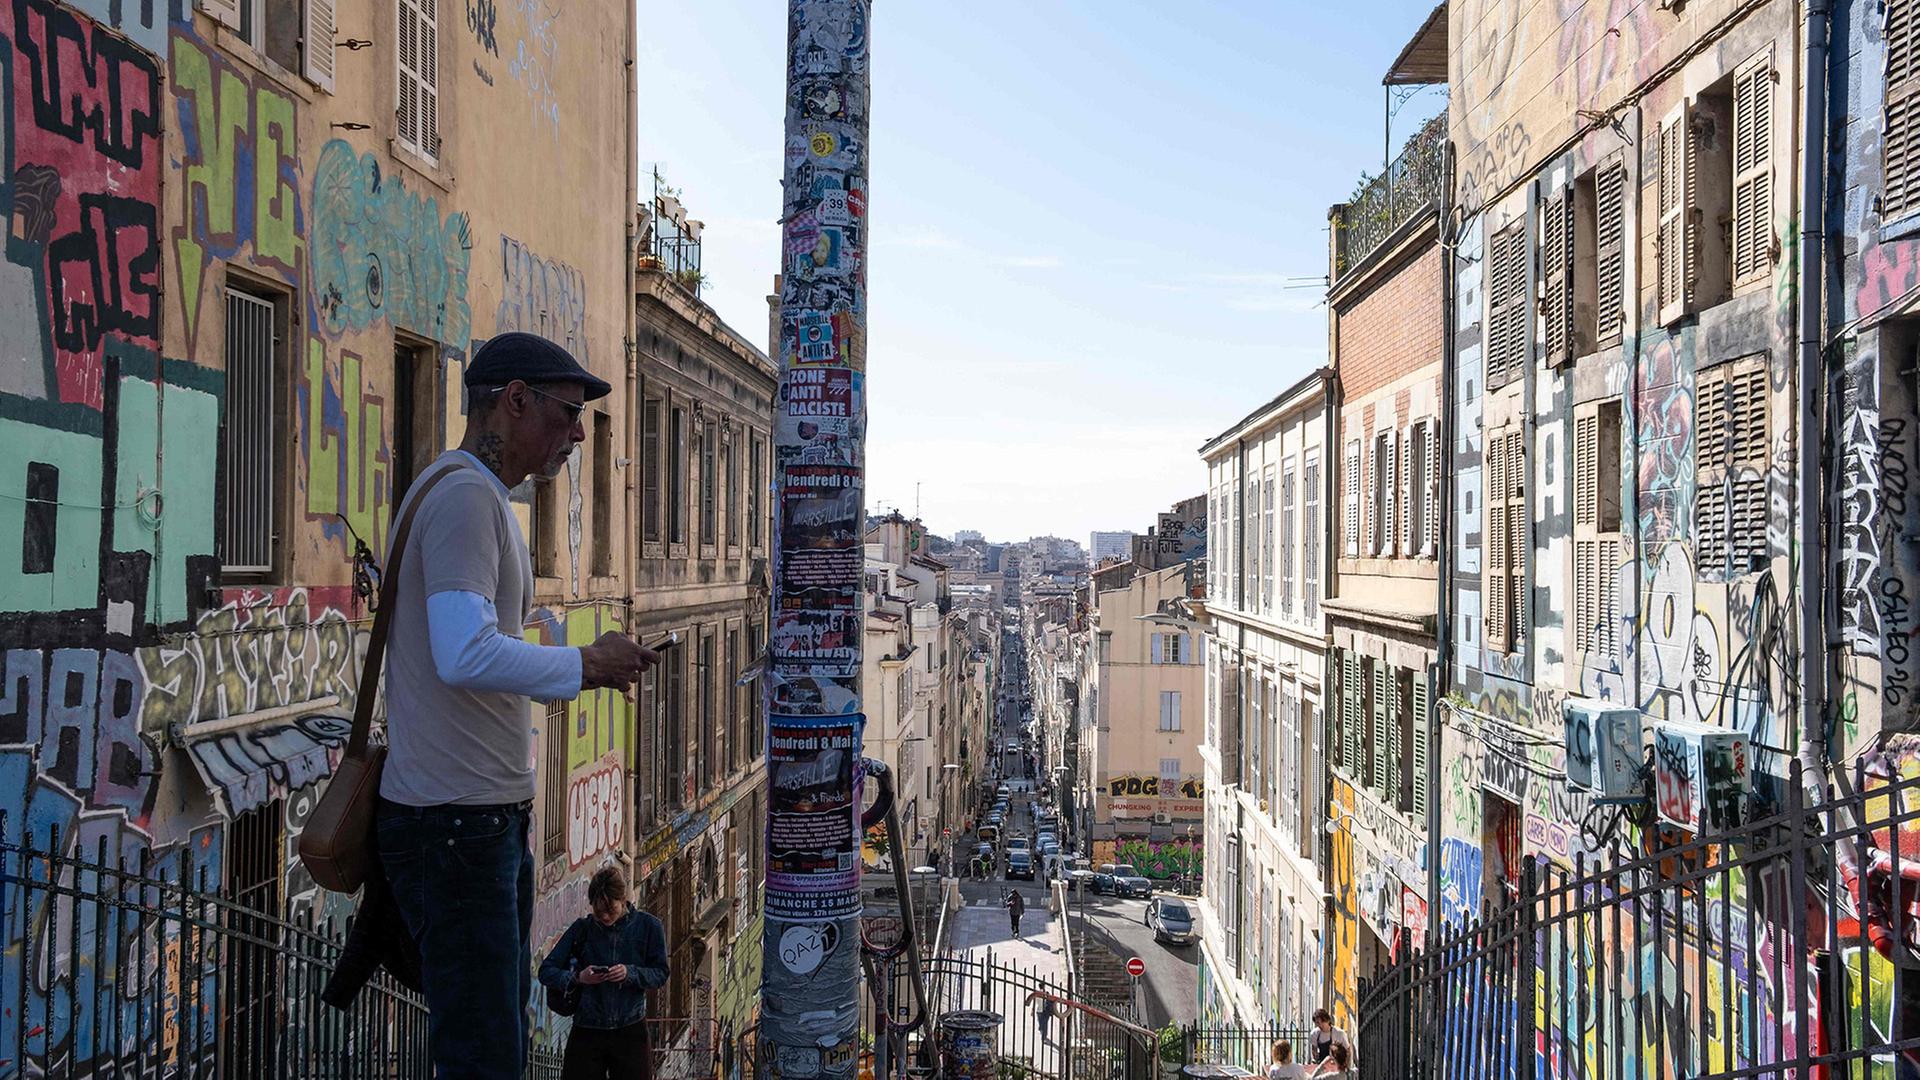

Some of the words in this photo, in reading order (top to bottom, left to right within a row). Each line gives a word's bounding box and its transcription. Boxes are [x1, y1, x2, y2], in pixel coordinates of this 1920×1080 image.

[829, 198, 843, 209] 39
[802, 343, 831, 358] ANTIFA
[790, 370, 826, 384] ZONE
[790, 386, 822, 399] ANTI
[790, 402, 846, 415] RACISTE
[786, 474, 841, 487] Vendredi
[842, 475, 850, 488] 8
[821, 737, 829, 750] 8
[832, 735, 851, 749] Mai
[1110, 776, 1159, 796] PDG
[1107, 803, 1152, 811] CHUNGKING
[767, 896, 818, 909] DIMANCHE
[821, 899, 834, 908] 15
[783, 933, 821, 966] QAZ
